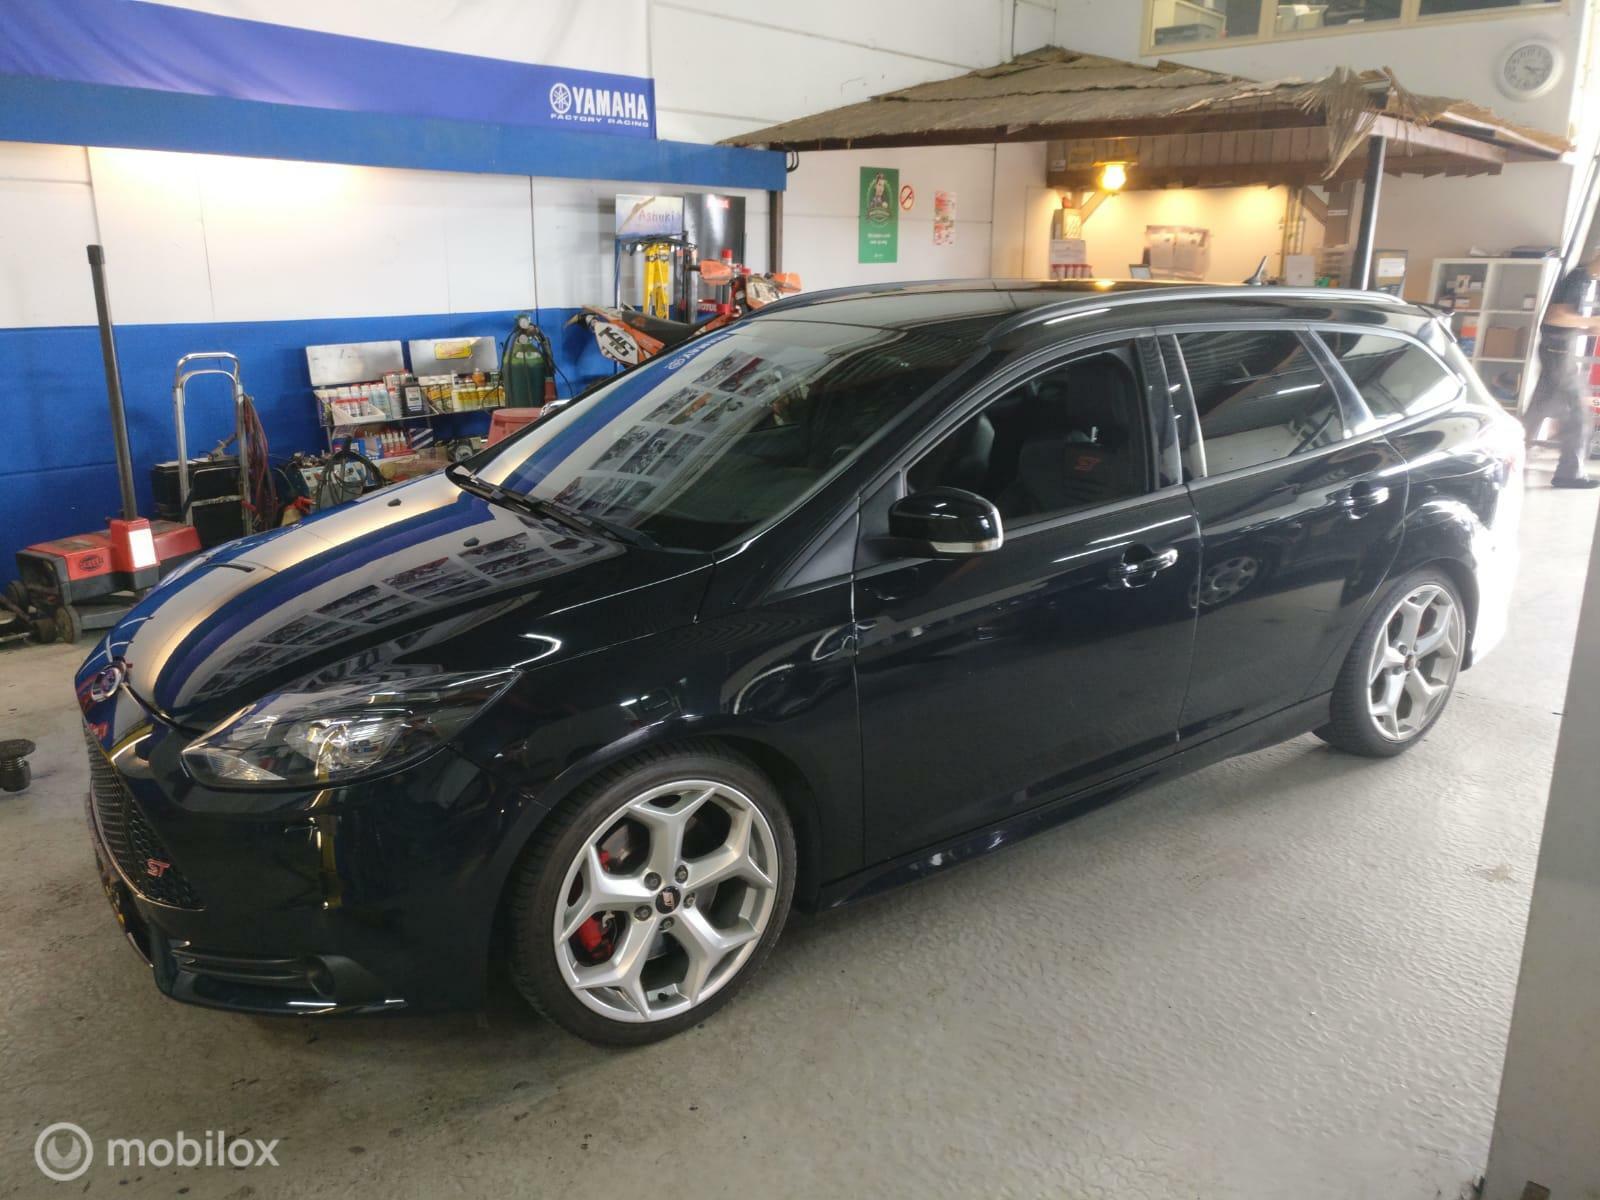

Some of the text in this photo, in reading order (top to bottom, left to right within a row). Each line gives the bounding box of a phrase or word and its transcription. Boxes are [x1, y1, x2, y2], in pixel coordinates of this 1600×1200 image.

[572, 86, 649, 121] YAMAHA
[550, 113, 649, 128] FACTORY RACING
[147, 858, 171, 877] ST
